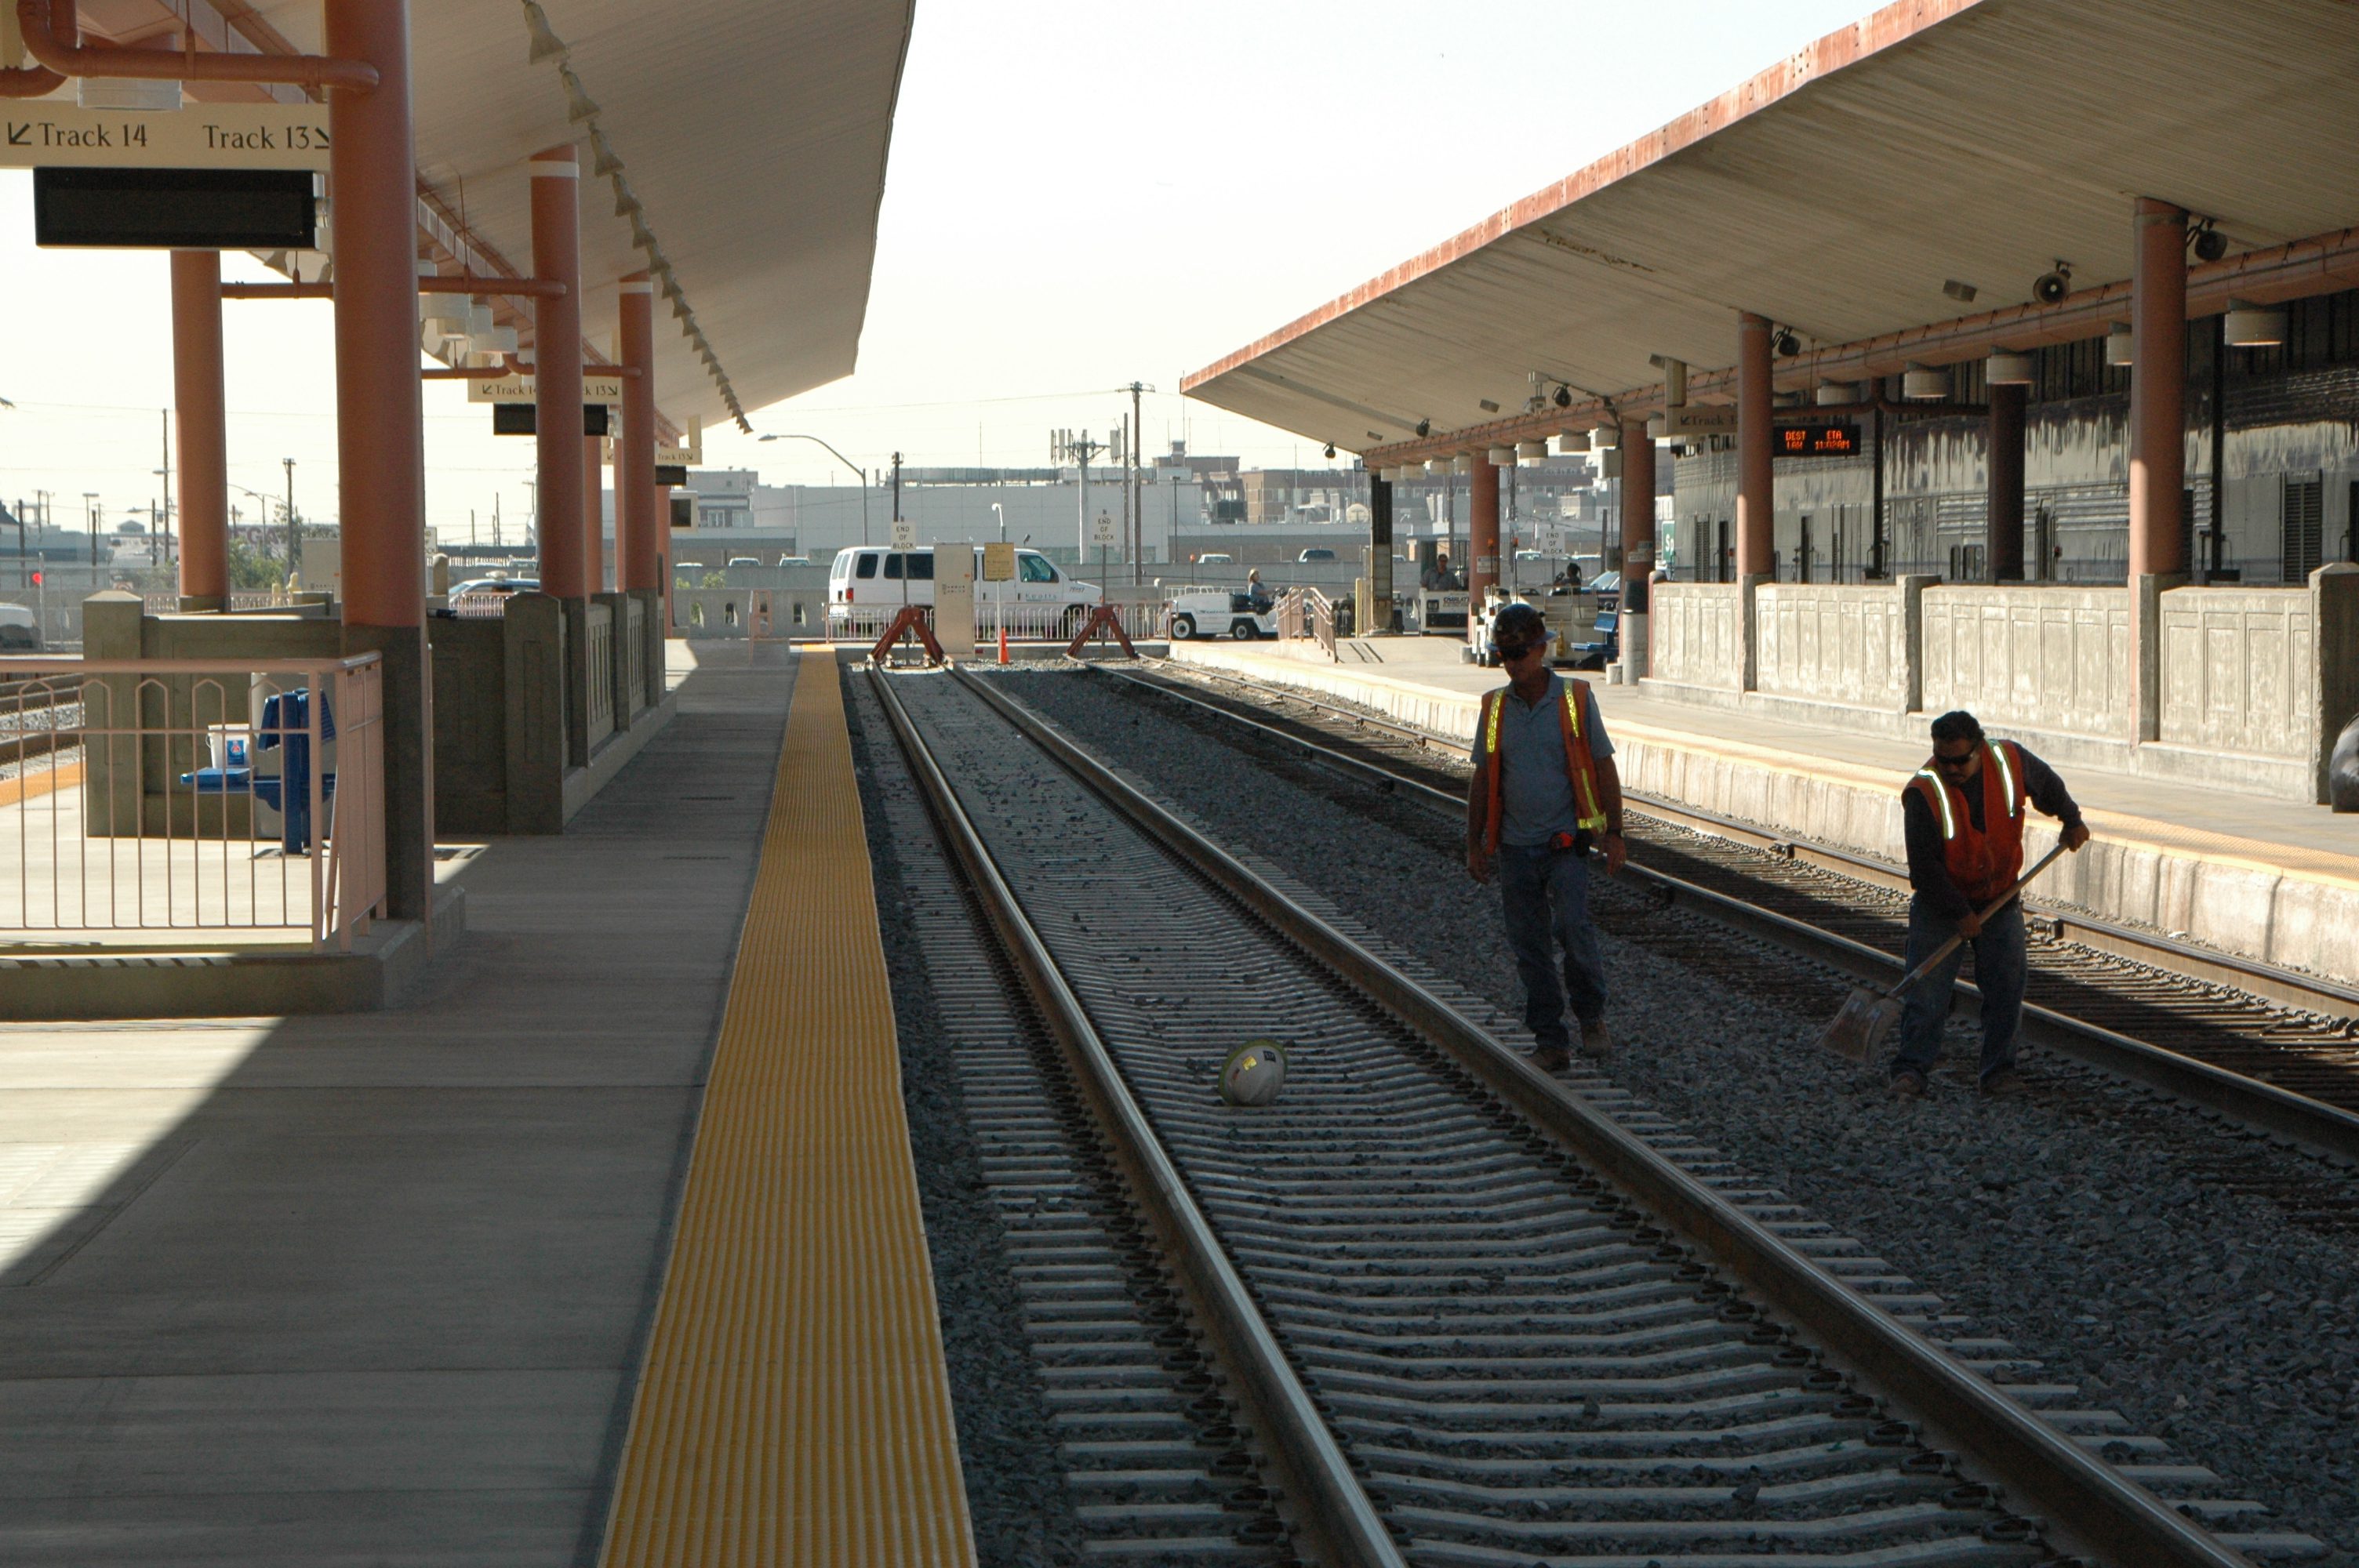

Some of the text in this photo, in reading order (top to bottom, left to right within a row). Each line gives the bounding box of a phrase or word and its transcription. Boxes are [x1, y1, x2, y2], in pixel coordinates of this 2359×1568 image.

[38, 122, 147, 148] Track 14
[202, 125, 311, 150] Track 13
[496, 384, 536, 396] Track 1
[597, 386, 606, 396] 13
[1692, 414, 1725, 426] Track
[1786, 430, 1841, 441] DEST ETA
[658, 452, 676, 461] Track
